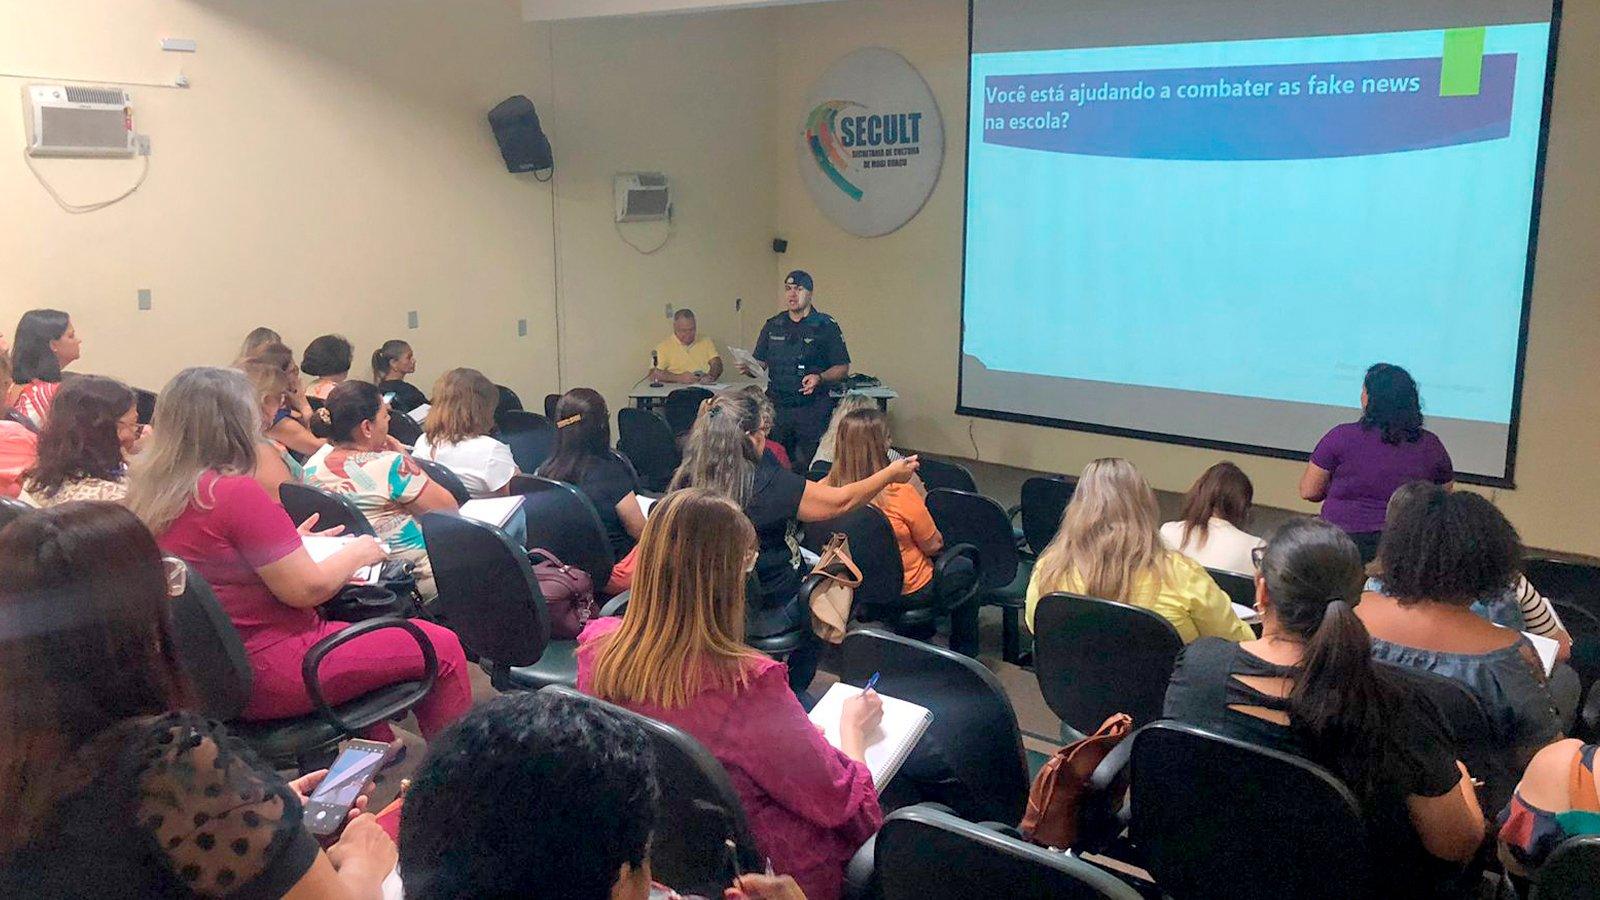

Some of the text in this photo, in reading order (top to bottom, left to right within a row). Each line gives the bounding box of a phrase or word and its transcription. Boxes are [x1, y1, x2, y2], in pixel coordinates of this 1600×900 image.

[985, 74, 1420, 106] Você está ajudando a combater as fake news
[841, 113, 922, 147] SECULT
[985, 111, 1070, 130] na escola?
